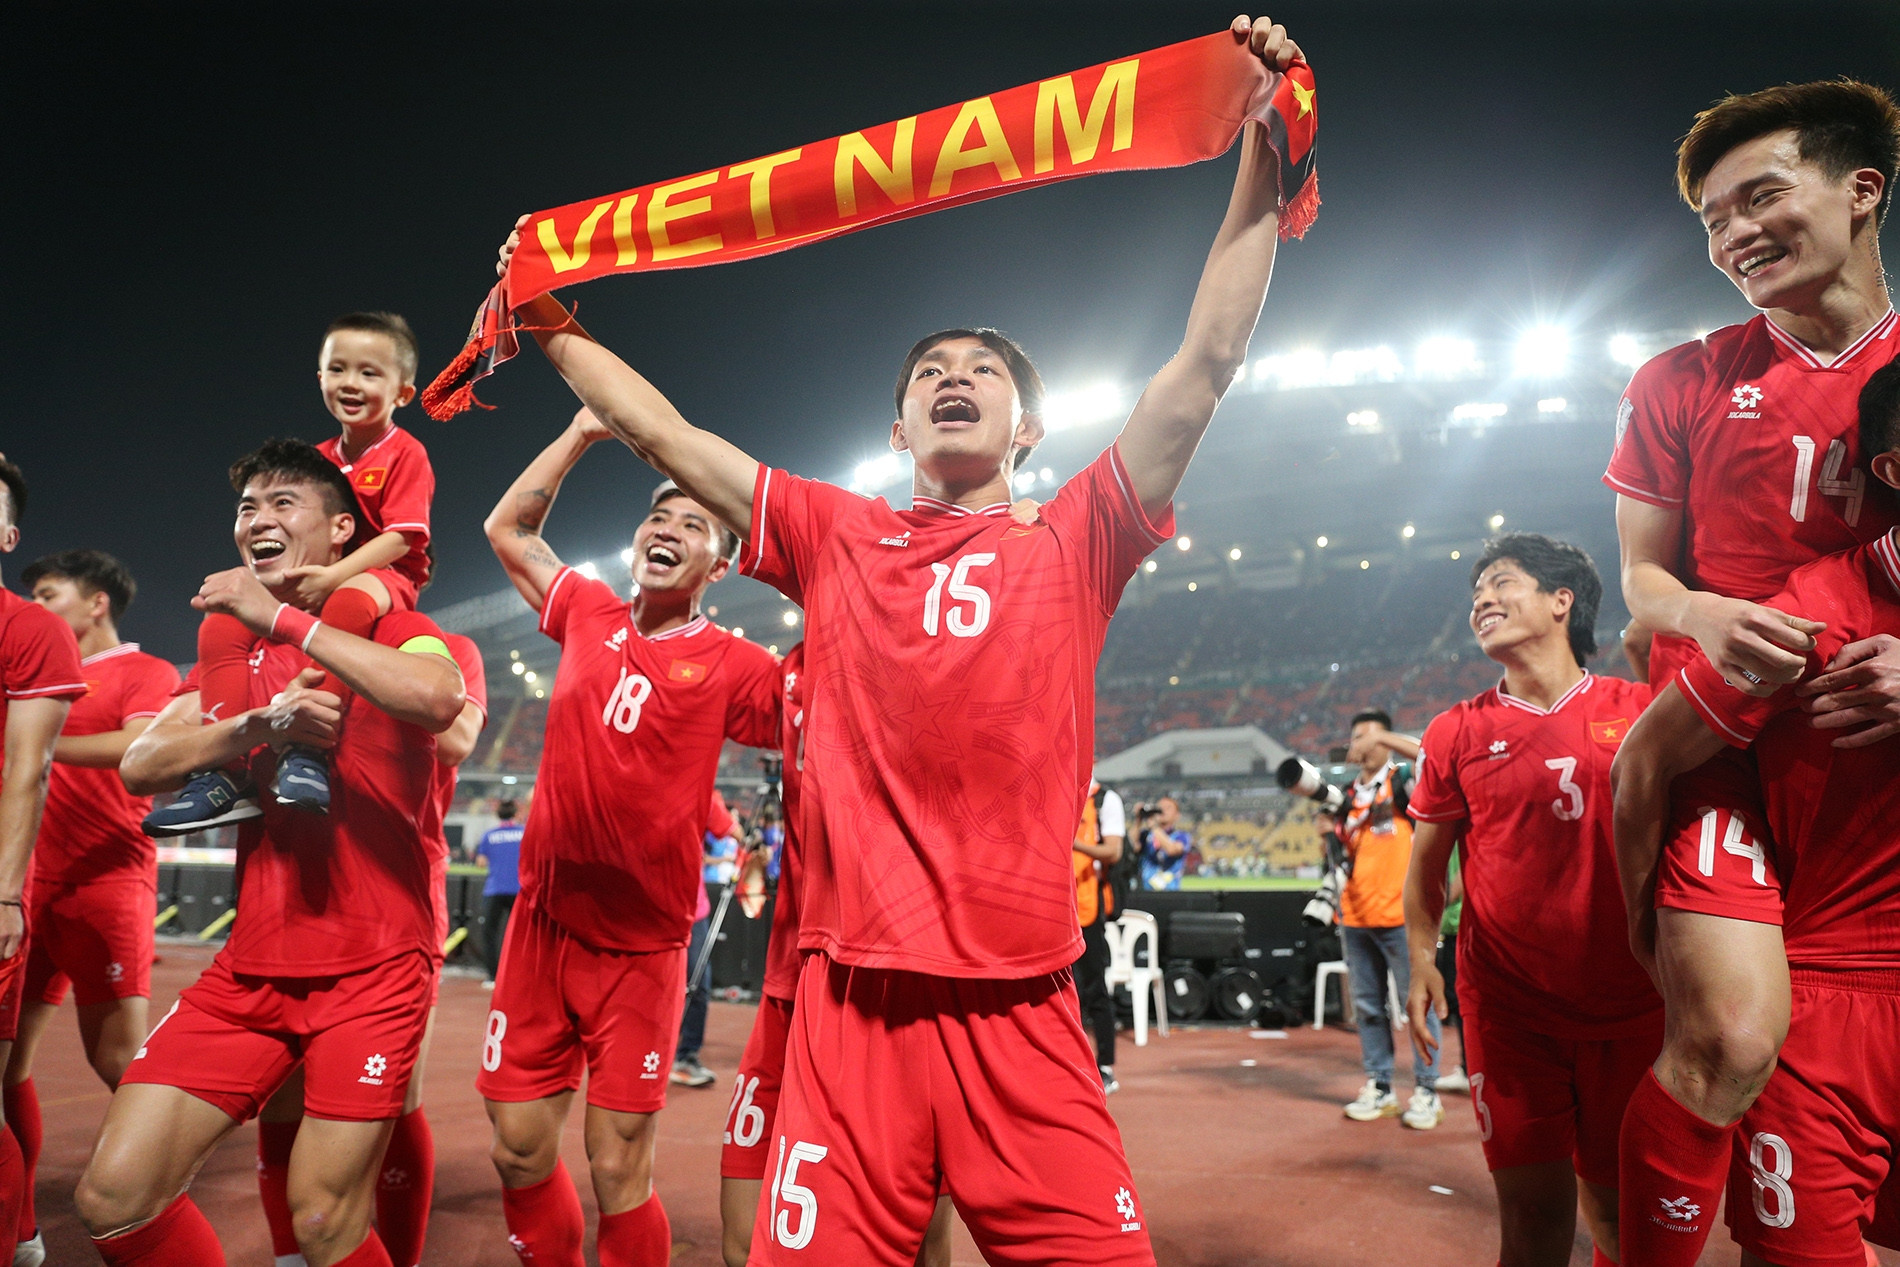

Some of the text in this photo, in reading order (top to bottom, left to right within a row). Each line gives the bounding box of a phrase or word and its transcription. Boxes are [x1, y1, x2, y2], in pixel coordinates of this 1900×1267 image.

[535, 59, 1140, 274] VIET NAM
[1790, 435, 1866, 528] 14
[922, 552, 996, 638] 15
[602, 666, 653, 734] 18
[1544, 756, 1584, 821] 3
[1696, 805, 1768, 886] 14
[723, 1073, 765, 1147] 26
[1470, 1072, 1493, 1142] 3
[770, 1135, 828, 1250] 15
[1750, 1131, 1796, 1229] 8
